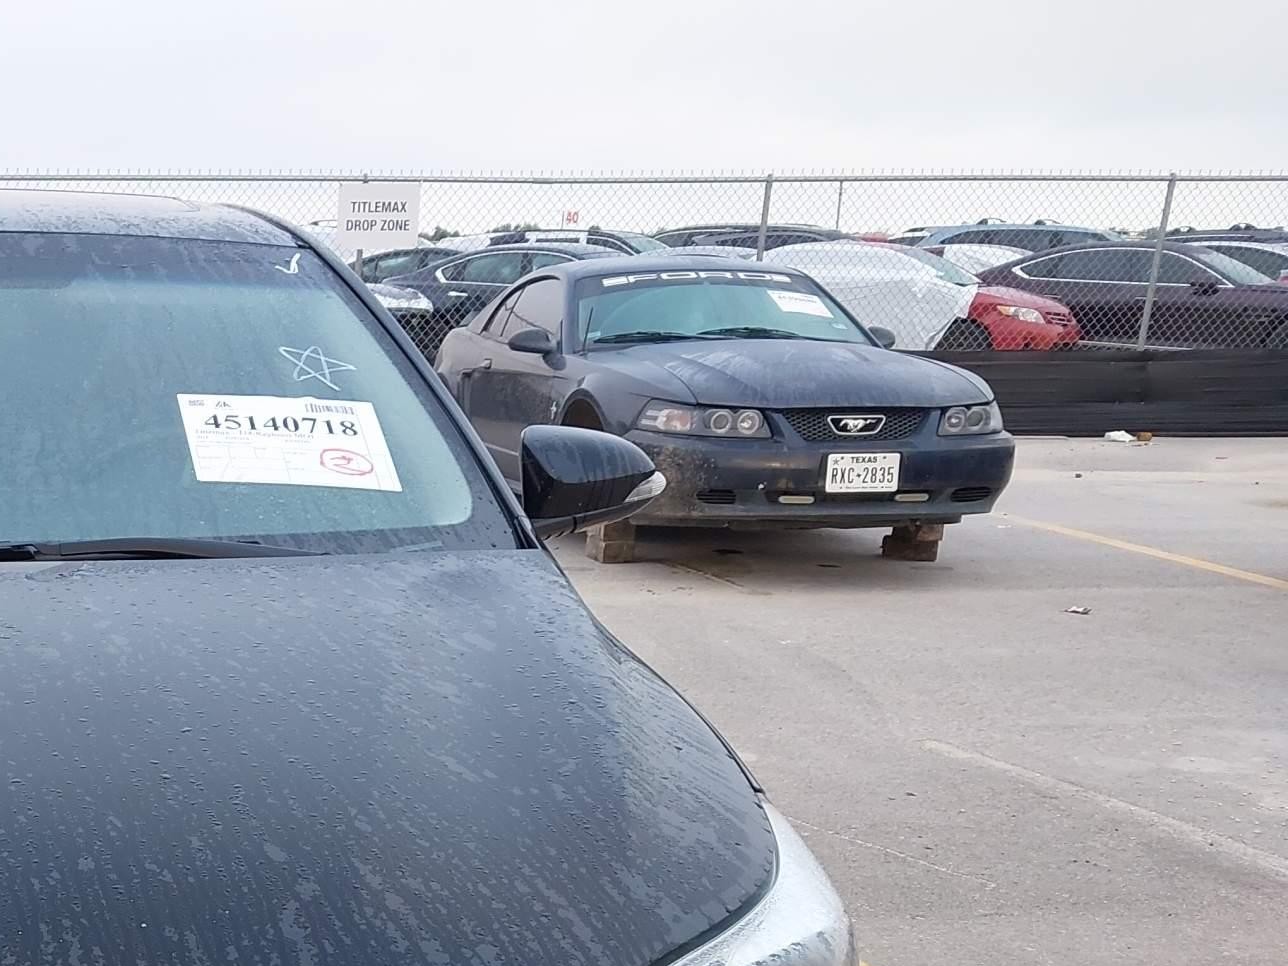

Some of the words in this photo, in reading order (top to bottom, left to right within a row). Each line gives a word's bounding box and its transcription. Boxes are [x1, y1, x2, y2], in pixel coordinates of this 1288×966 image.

[351, 201, 407, 213] TITLEMAX
[346, 219, 377, 231] DROP
[380, 219, 410, 231] ZONE
[627, 271, 773, 283] FORD
[204, 413, 359, 437] 45140718
[850, 456, 878, 464] TEXAS
